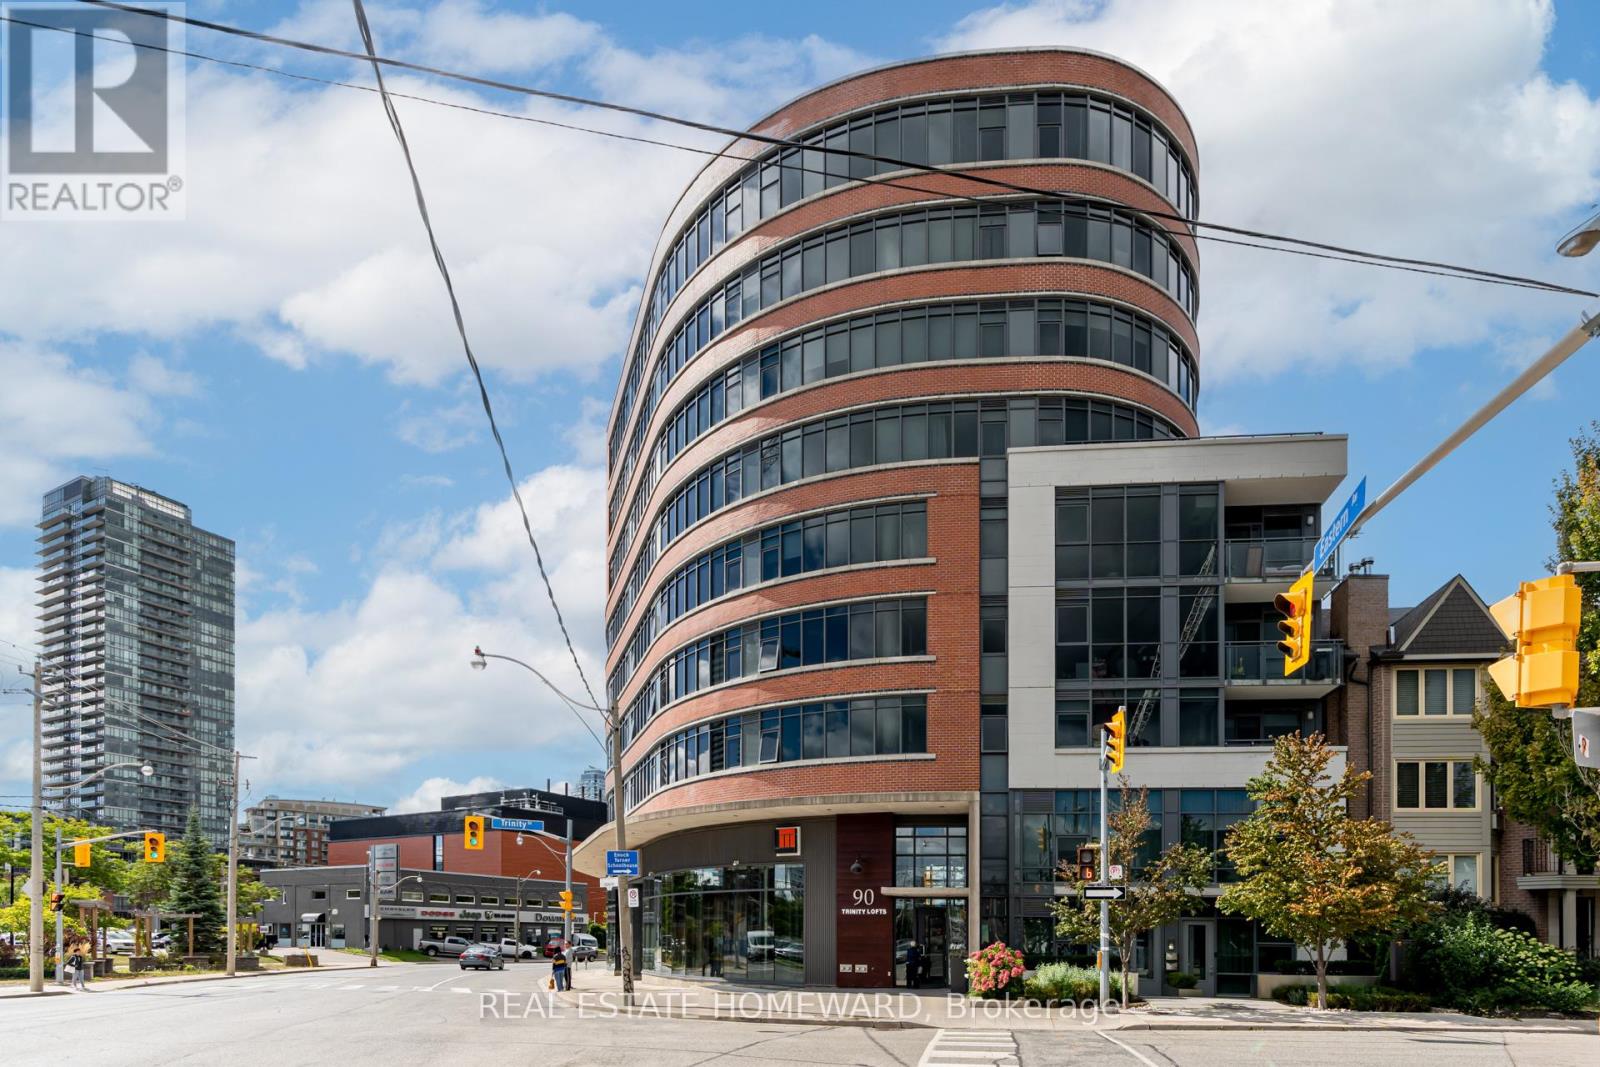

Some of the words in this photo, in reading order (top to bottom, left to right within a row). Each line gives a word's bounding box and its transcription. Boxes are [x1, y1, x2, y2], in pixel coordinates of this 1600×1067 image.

[1319, 508, 1349, 559] Eastern
[501, 818, 528, 830] Trinity
[852, 888, 875, 906] 90
[459, 909, 481, 920] Jeep
